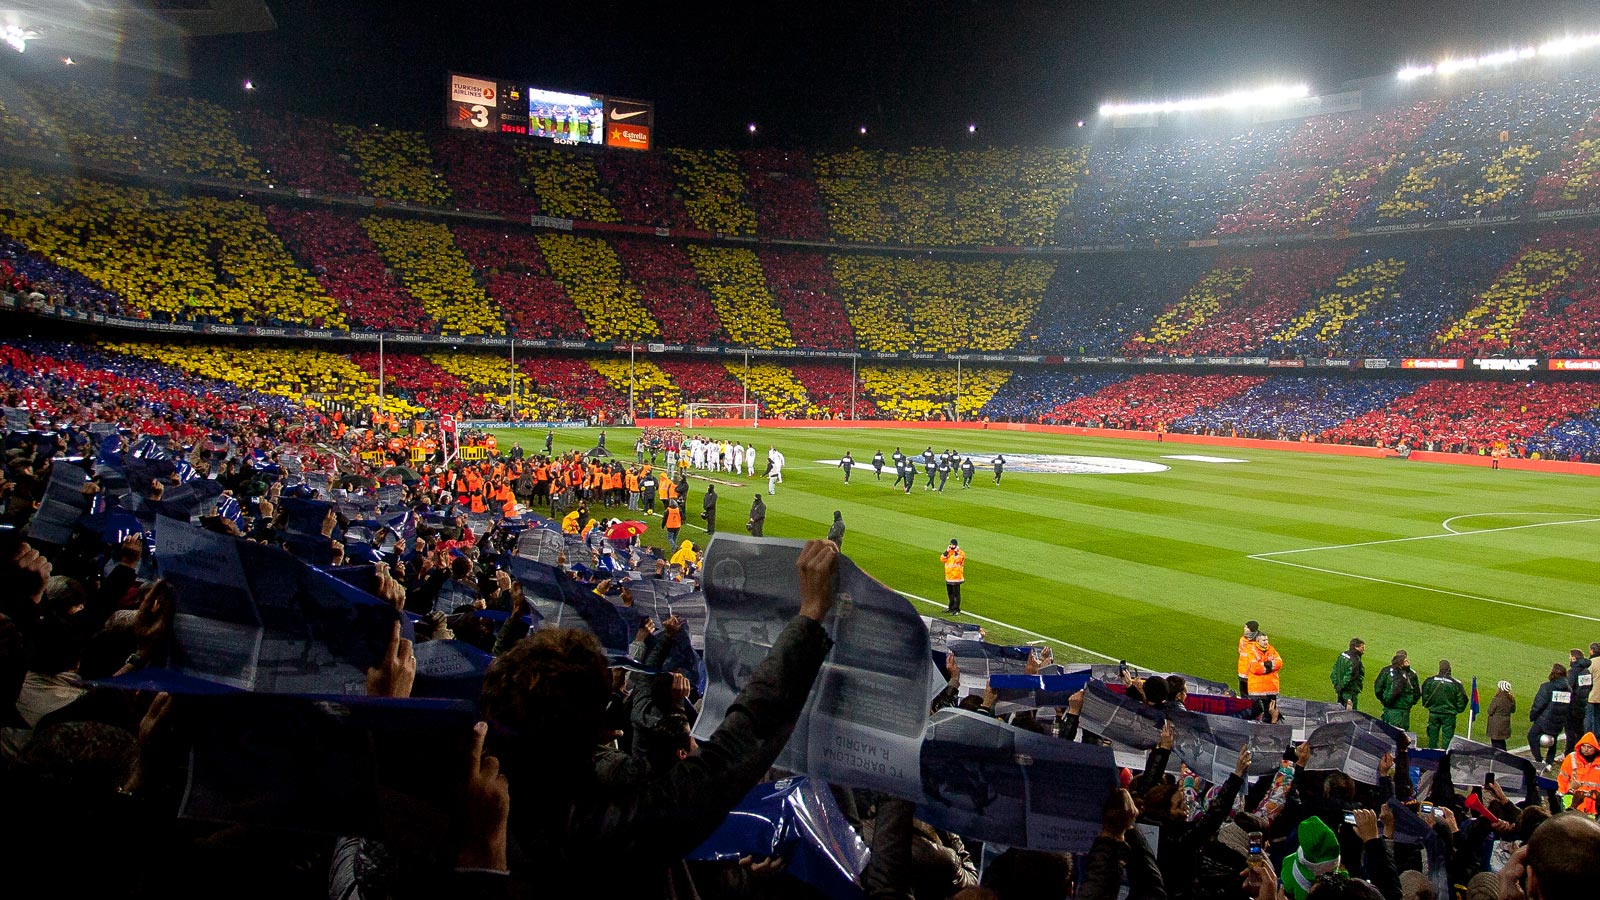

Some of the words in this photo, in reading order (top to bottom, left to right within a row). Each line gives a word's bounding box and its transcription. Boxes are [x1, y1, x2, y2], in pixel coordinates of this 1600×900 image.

[454, 84, 482, 92] TURKISH
[471, 105, 488, 127] 3
[622, 130, 646, 140] Estrella
[554, 138, 579, 146] SONY
[211, 325, 238, 334] Spanair
[256, 328, 285, 336] Spanair
[304, 330, 332, 338] Spanair
[351, 332, 378, 340] Spanair
[396, 334, 423, 342] Spanair
[522, 339, 547, 347] Spanair
[836, 737, 876, 756] MADRID
[880, 748, 889, 761] R.
[823, 747, 886, 774] BARCELONA
[889, 766, 904, 779] FC
